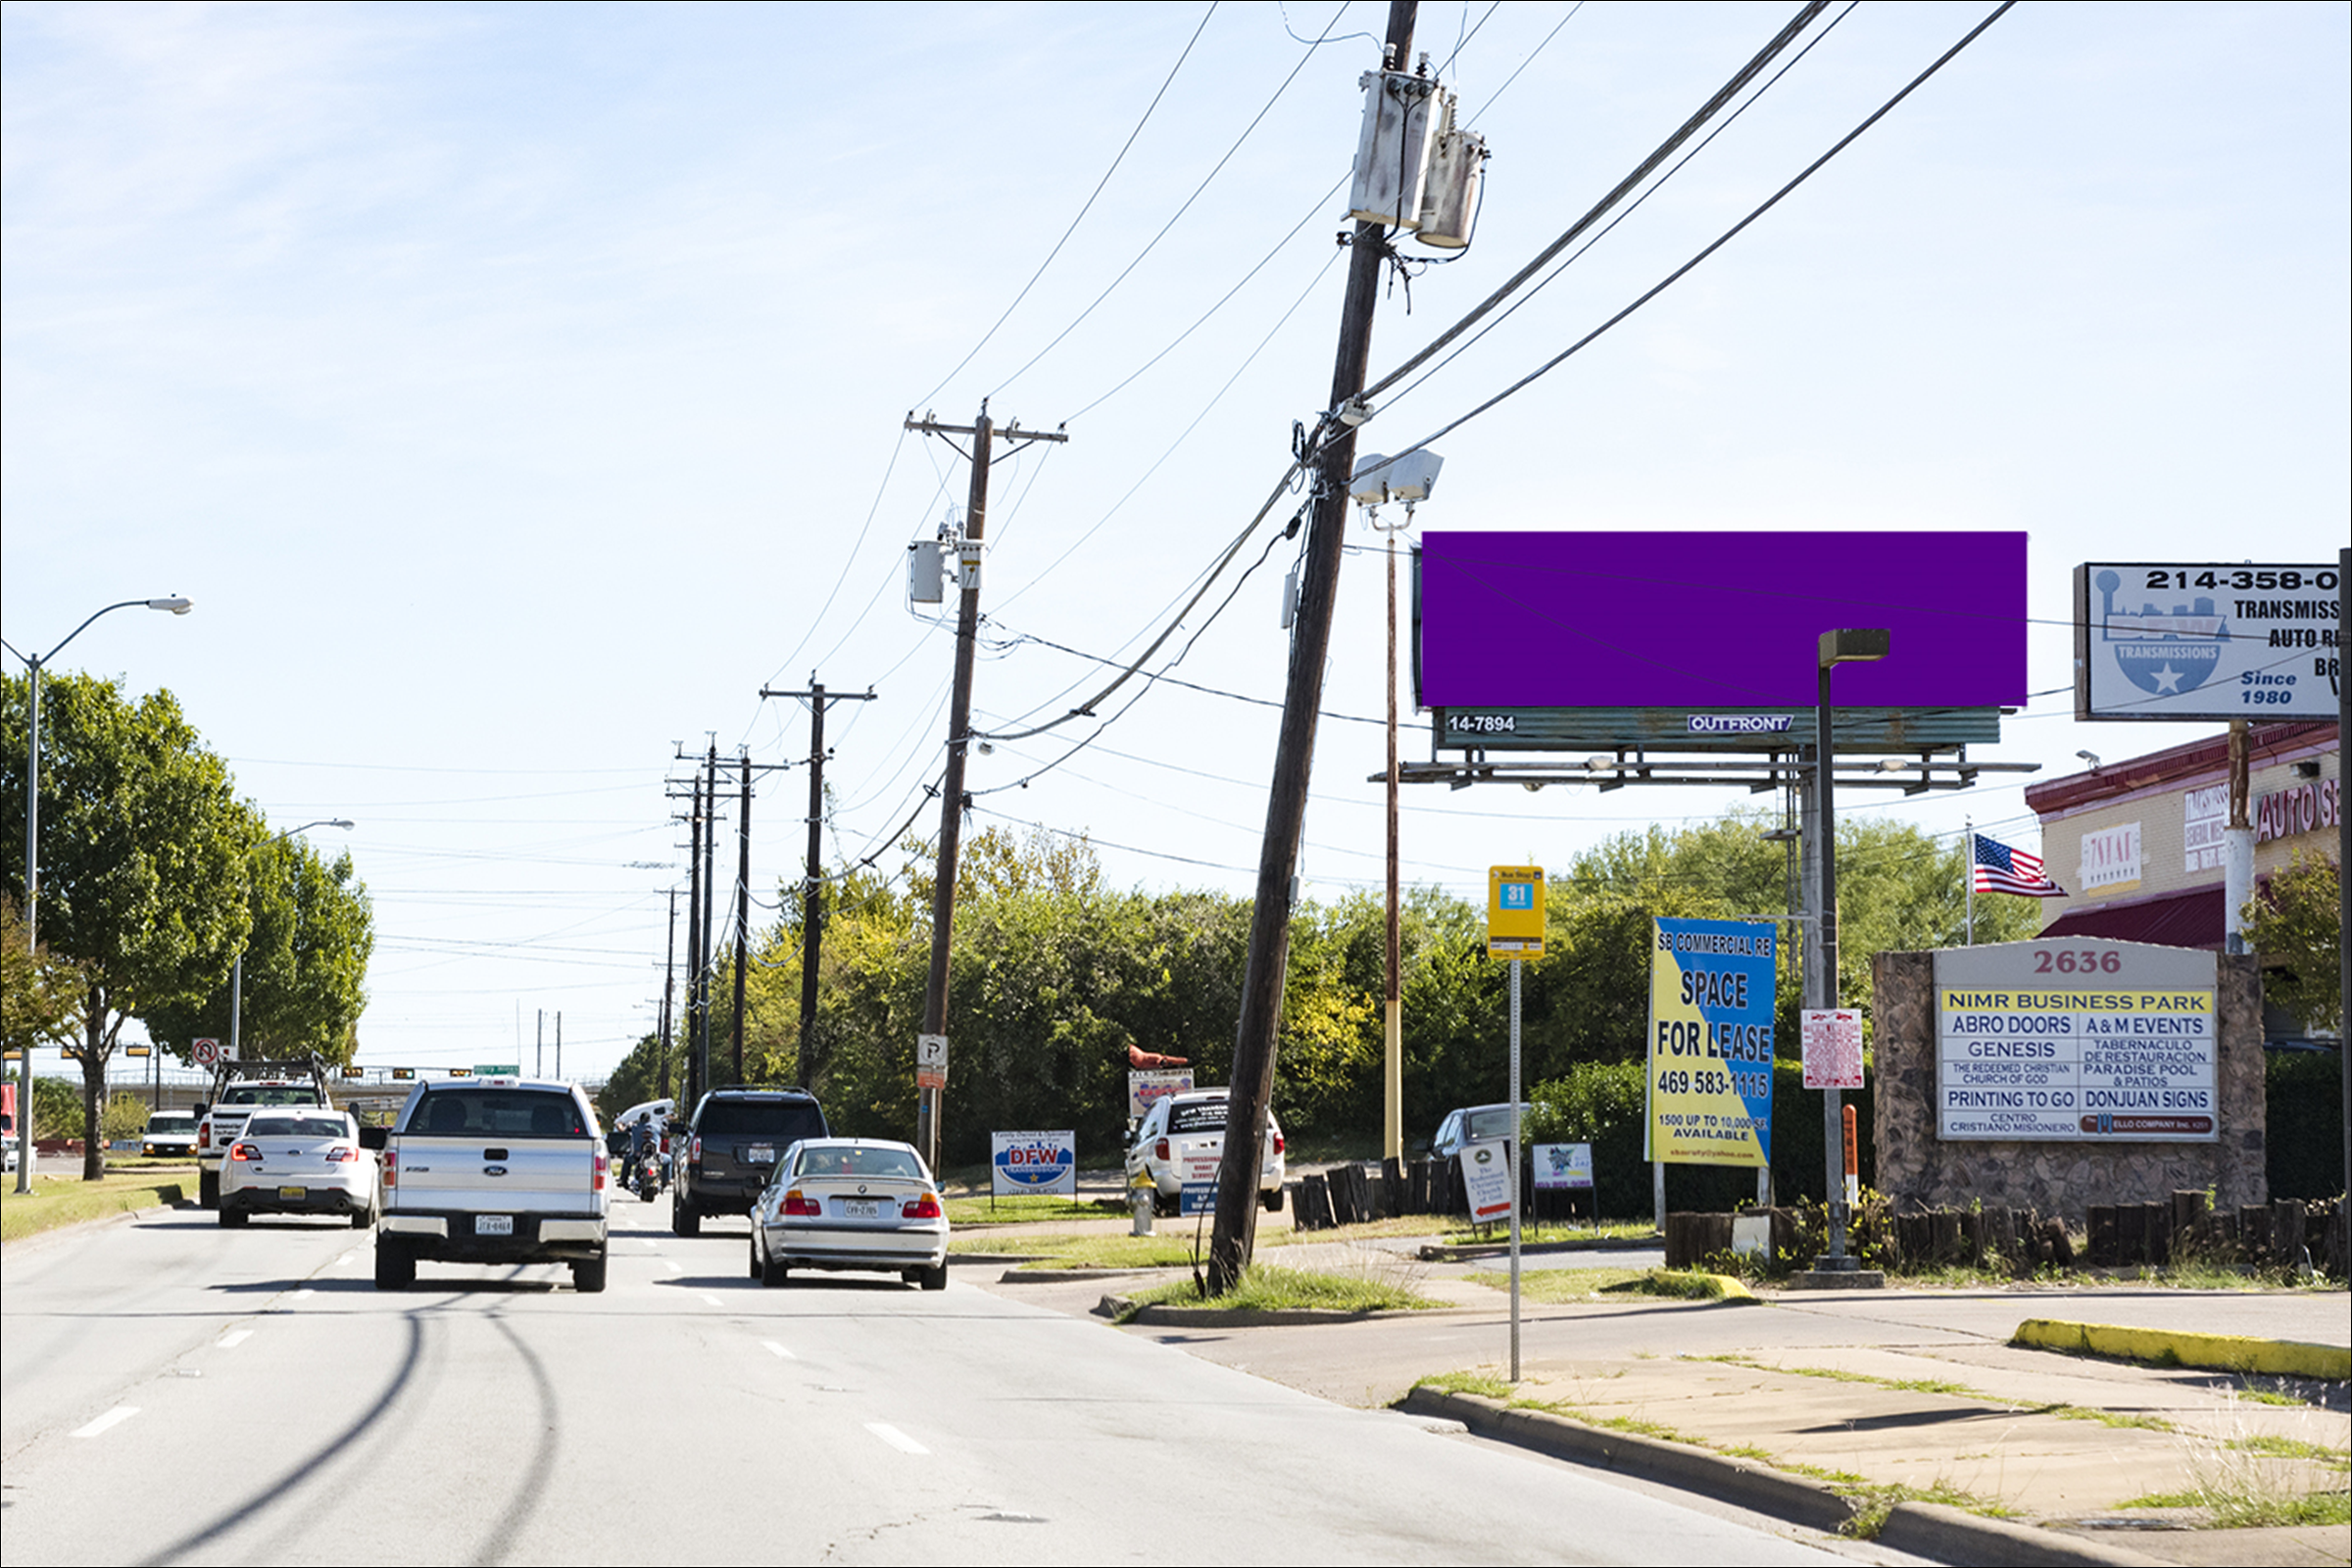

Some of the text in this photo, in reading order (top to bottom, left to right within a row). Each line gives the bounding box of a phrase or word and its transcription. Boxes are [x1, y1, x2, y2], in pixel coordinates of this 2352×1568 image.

[2146, 570, 2339, 590] 214-358-0
[2234, 600, 2339, 619] TRANSMISS
[2269, 628, 2317, 648] AUTO
[2118, 645, 2217, 660] TRANSMISSIONS
[2315, 658, 2339, 676] BR
[2241, 670, 2296, 685] Since
[2241, 690, 2291, 704] 1980
[1448, 716, 1515, 731] 14-7894
[1691, 716, 1789, 731] OUTFRONT
[2258, 778, 2340, 842] AUTO SE
[1508, 885, 1525, 901] 31
[1658, 933, 1771, 956] SB COMMERCIAL RE
[2034, 951, 2122, 974] 2636
[1681, 970, 1747, 1008] SPACE
[1949, 994, 2205, 1010] NIMR BUSINESS PARK
[1952, 1015, 2071, 1034] ABRO DOORS
[2086, 1017, 2203, 1034] A & M EVENTS
[1658, 1020, 1700, 1056] FOR
[1707, 1022, 1771, 1063] LEASE
[2094, 1040, 2192, 1051] TABERNACULO
[1968, 1042, 2055, 1057] GENESIS
[2084, 1052, 2206, 1062] DE RESTAURACION
[1953, 1063, 2070, 1074] THE REDEEMED CHRISTIAN
[2083, 1064, 2197, 1075] PARADISE POOL
[1658, 1070, 1768, 1099] 469 583-1115
[1963, 1074, 2048, 1084] CHURCH OF GOD
[2114, 1076, 2168, 1087] & PATIOS
[1948, 1091, 2075, 1106] PRINTING TO GO
[2086, 1092, 2209, 1107] DONJUAN SIGNS
[1659, 1114, 1684, 1126] 1500
[1686, 1114, 1700, 1126] UP
[1704, 1115, 1718, 1127] TO
[1721, 1116, 1752, 1131] 10,000
[1990, 1113, 2036, 1122] CENTRO
[2135, 1120, 2175, 1129] COMPANY
[1673, 1128, 1748, 1141] AVAILABLE
[1950, 1122, 2075, 1132] CRISTIANO MISIONERO
[1010, 1149, 1057, 1164] DFW
